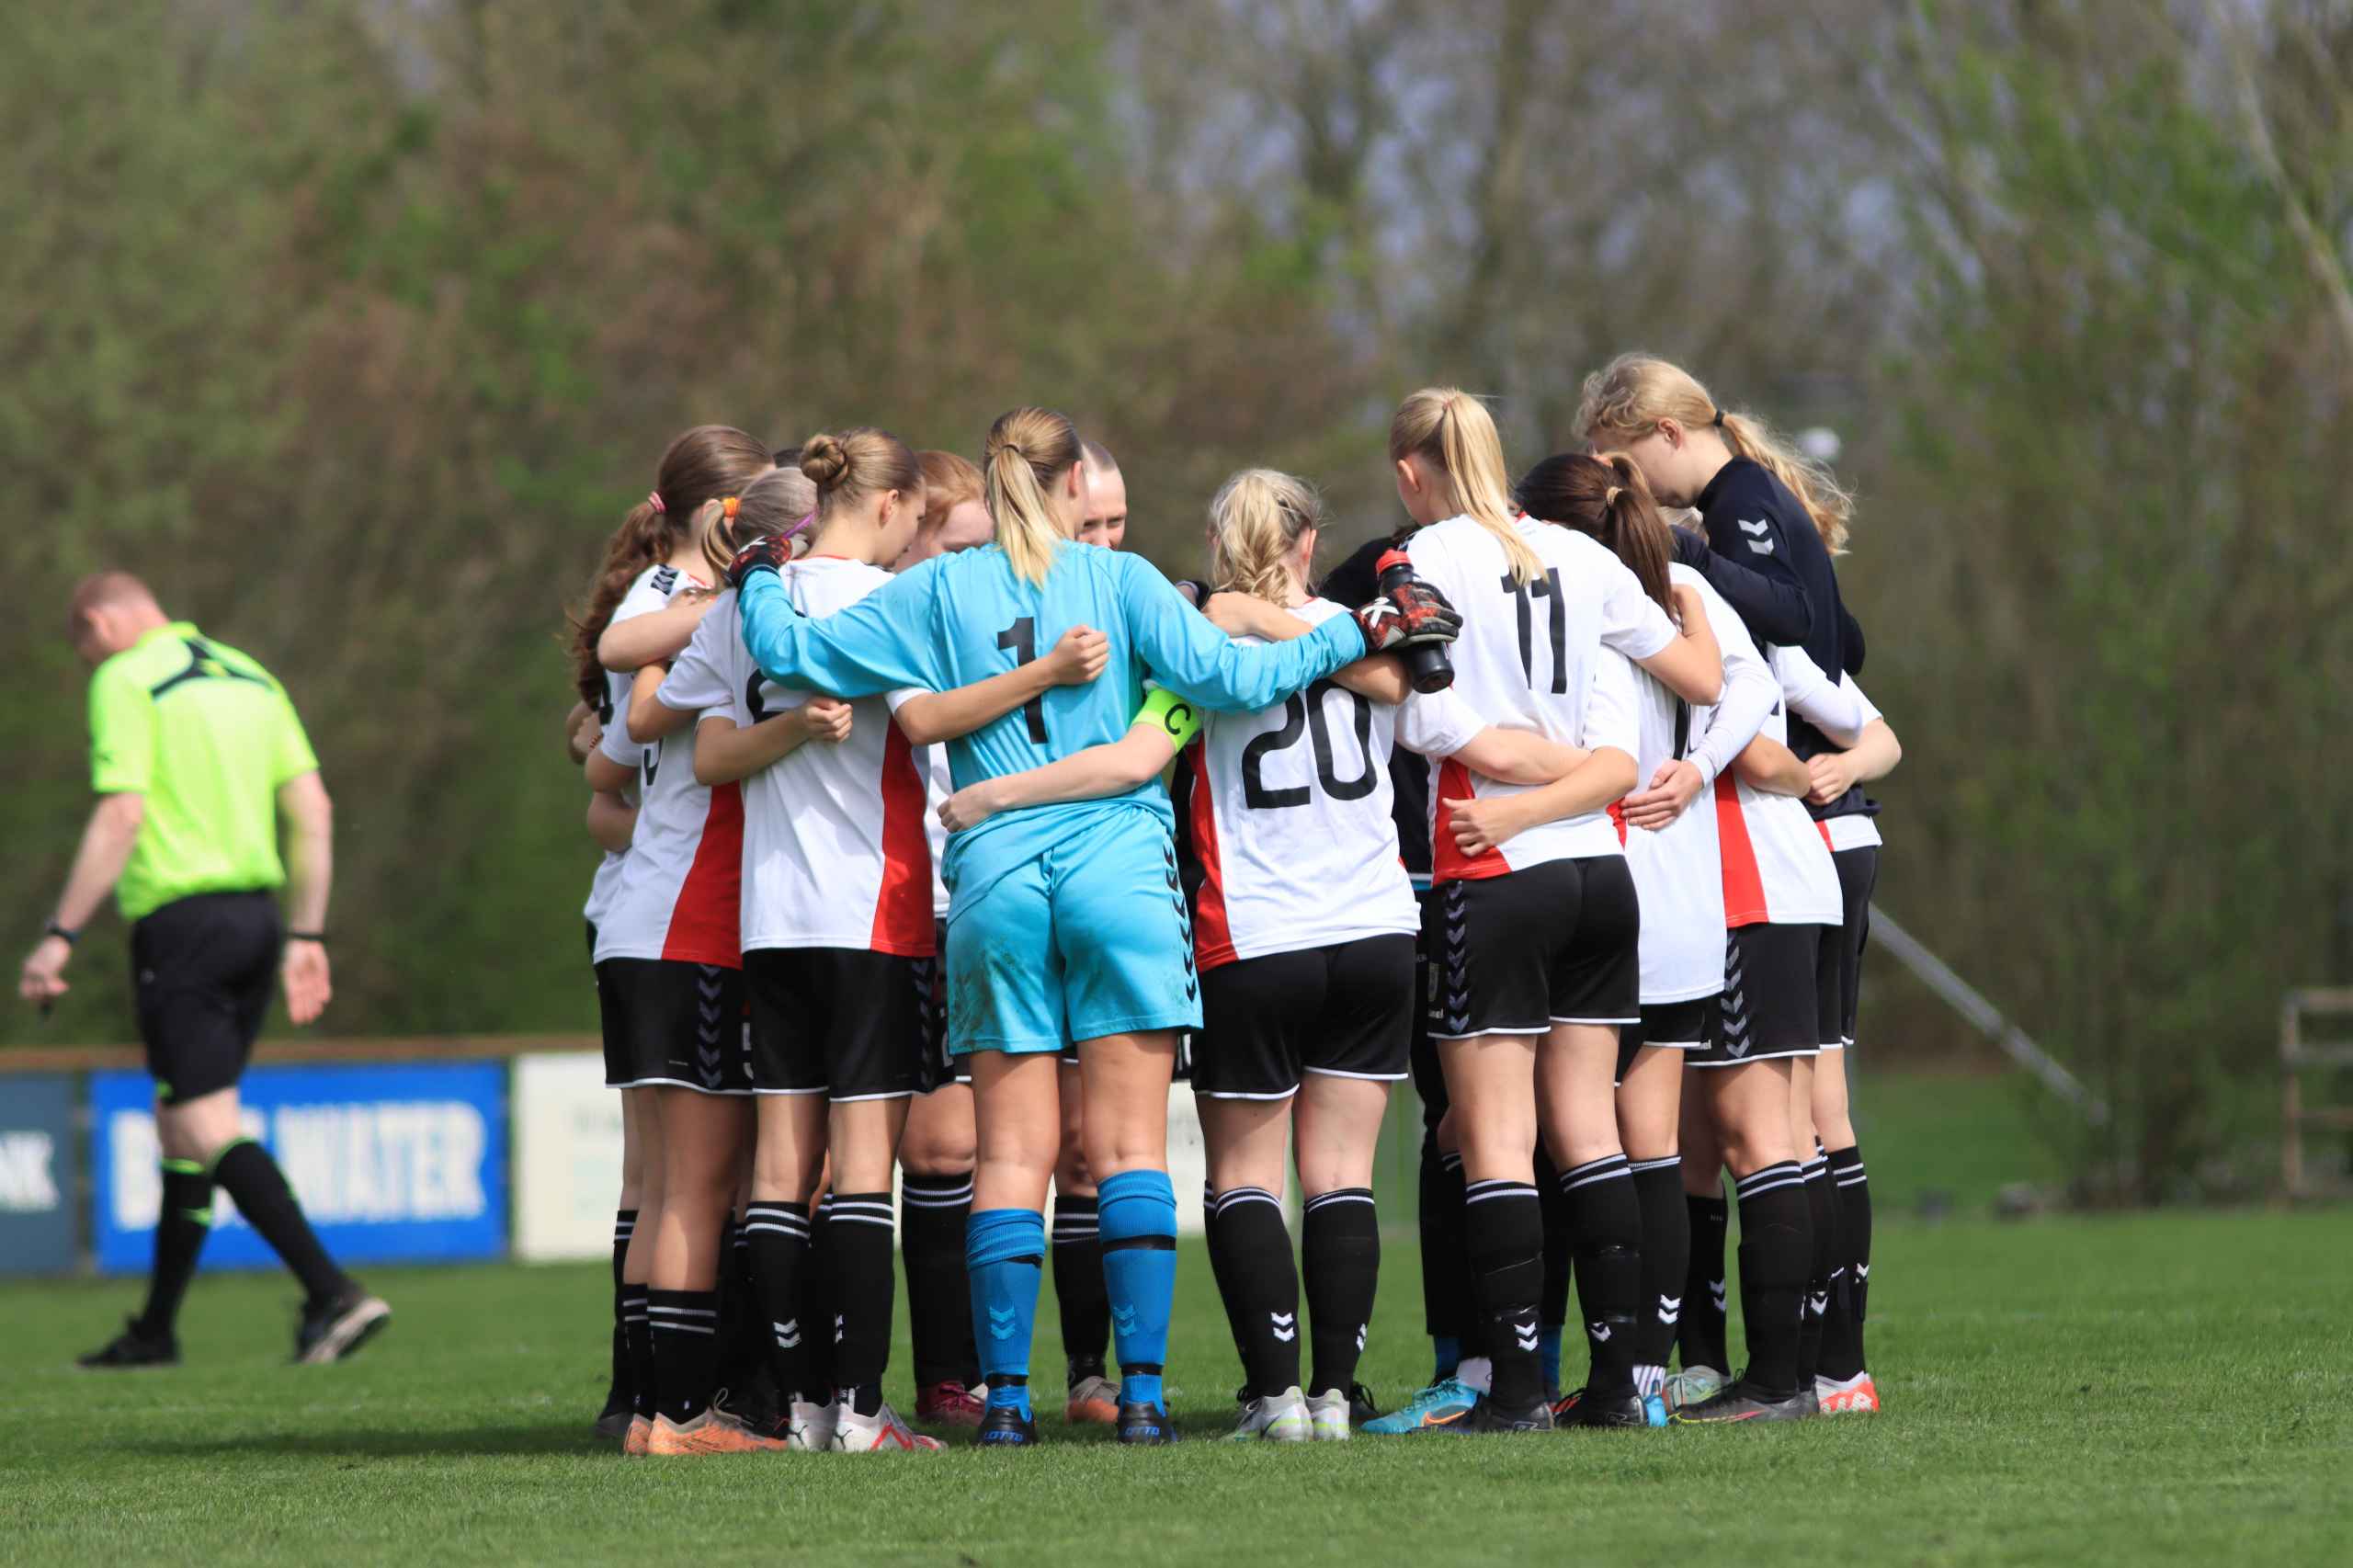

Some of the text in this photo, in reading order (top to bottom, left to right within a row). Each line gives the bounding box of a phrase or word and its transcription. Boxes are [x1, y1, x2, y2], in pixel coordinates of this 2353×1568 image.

[997, 617, 1048, 744] 1
[1500, 566, 1566, 694] 11
[1165, 703, 1191, 735] C
[1242, 678, 1378, 809] 20
[276, 1101, 484, 1222] WATER
